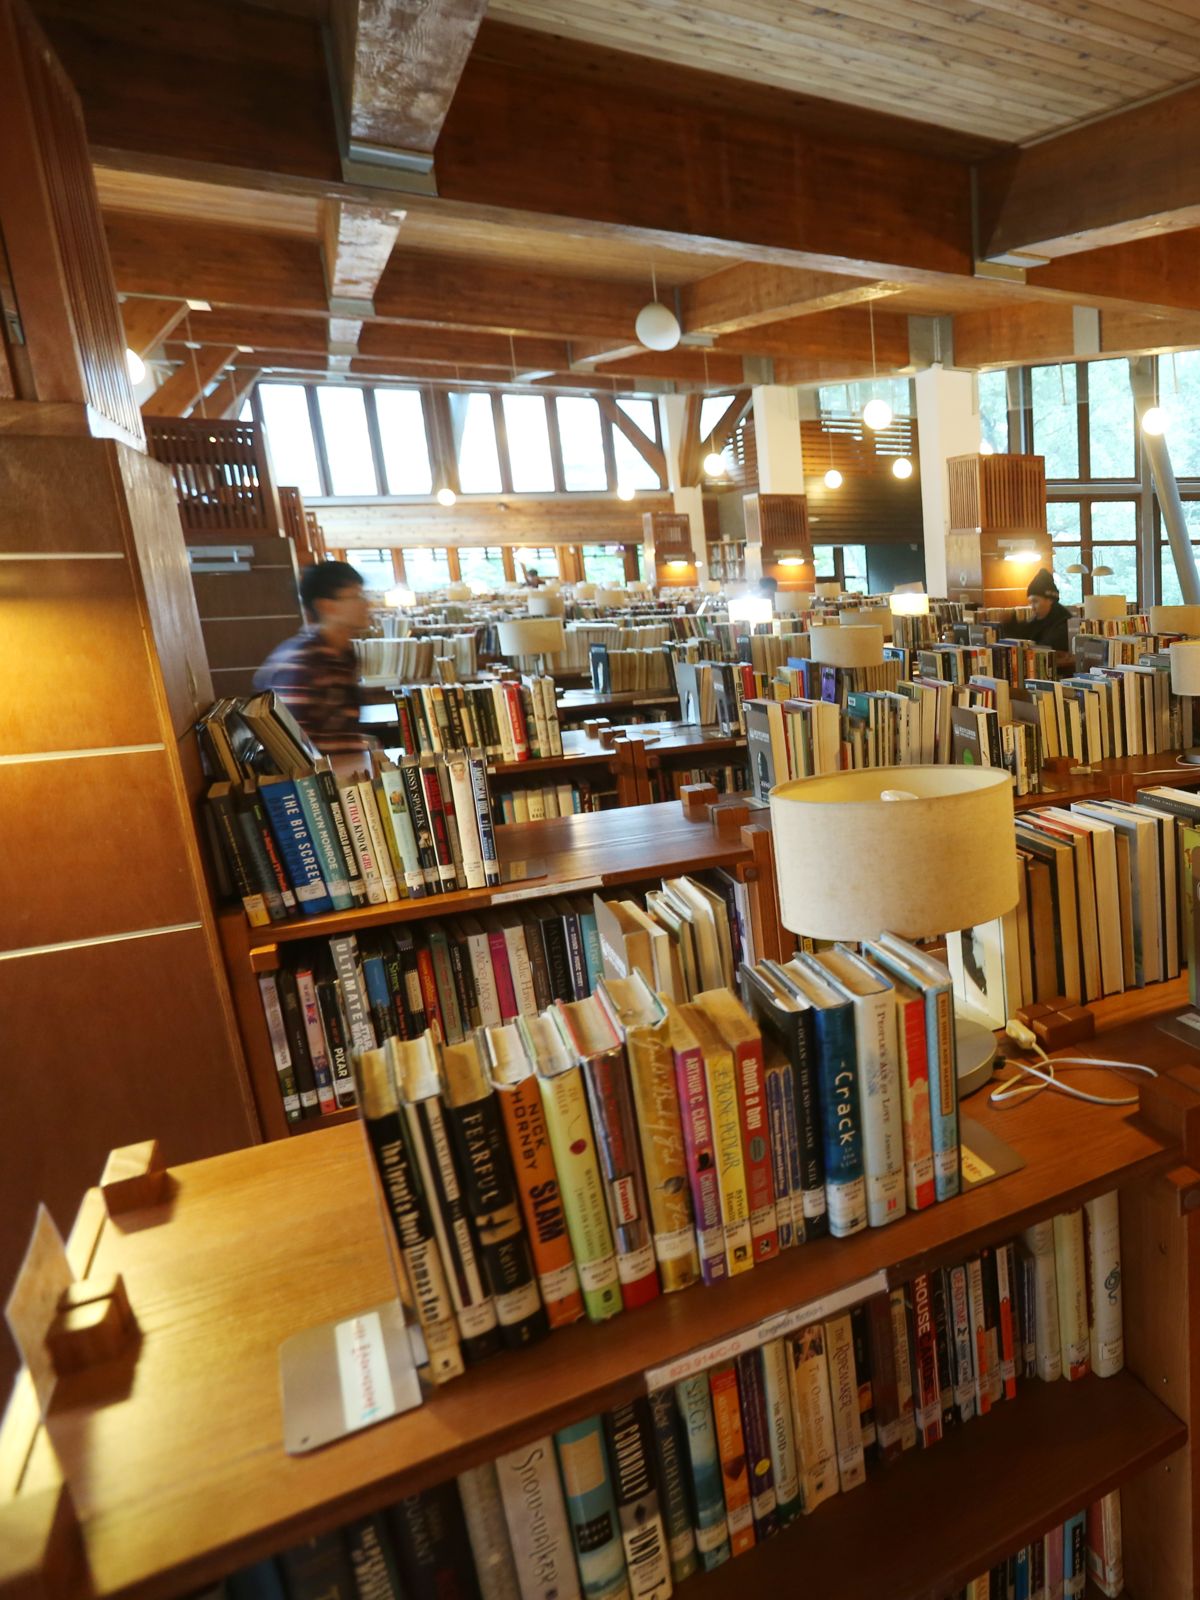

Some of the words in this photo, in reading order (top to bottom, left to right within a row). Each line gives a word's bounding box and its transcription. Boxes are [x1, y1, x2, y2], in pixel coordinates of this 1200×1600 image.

[281, 793, 300, 816] THE
[346, 789, 356, 805] NOT
[349, 804, 361, 825] THAT
[411, 793, 425, 829] SPACEK
[290, 818, 307, 840] BIG
[306, 788, 326, 833] MARILYN
[318, 830, 338, 871] MONROE
[354, 824, 366, 843] KIND
[361, 852, 373, 871] GIRL
[335, 942, 364, 1021] ULTIMATE
[480, 977, 493, 1013] MOUSE
[333, 1047, 348, 1077] PIXAR
[684, 1056, 702, 1094] ARTHUR
[741, 1056, 760, 1096] about
[689, 1095, 702, 1106] C.
[744, 1096, 757, 1106] a
[744, 1106, 762, 1131] boy
[834, 1071, 857, 1146] Crack
[511, 1089, 538, 1170] HORNBY
[527, 1102, 547, 1151] NICK
[689, 1107, 708, 1145] CLARKE
[381, 1139, 404, 1166] The
[461, 1111, 500, 1205] FEARFUL
[528, 1179, 565, 1245] SLAM
[618, 1179, 634, 1223] framed
[406, 1245, 435, 1295] Thomas
[914, 1274, 930, 1336] HOUSE
[757, 1315, 792, 1341] English
[836, 1342, 852, 1414] ROPEMAKER
[774, 1417, 787, 1454] GOOD
[613, 1422, 648, 1500] CONNOLLY
[661, 1436, 686, 1500] MICHAEL
